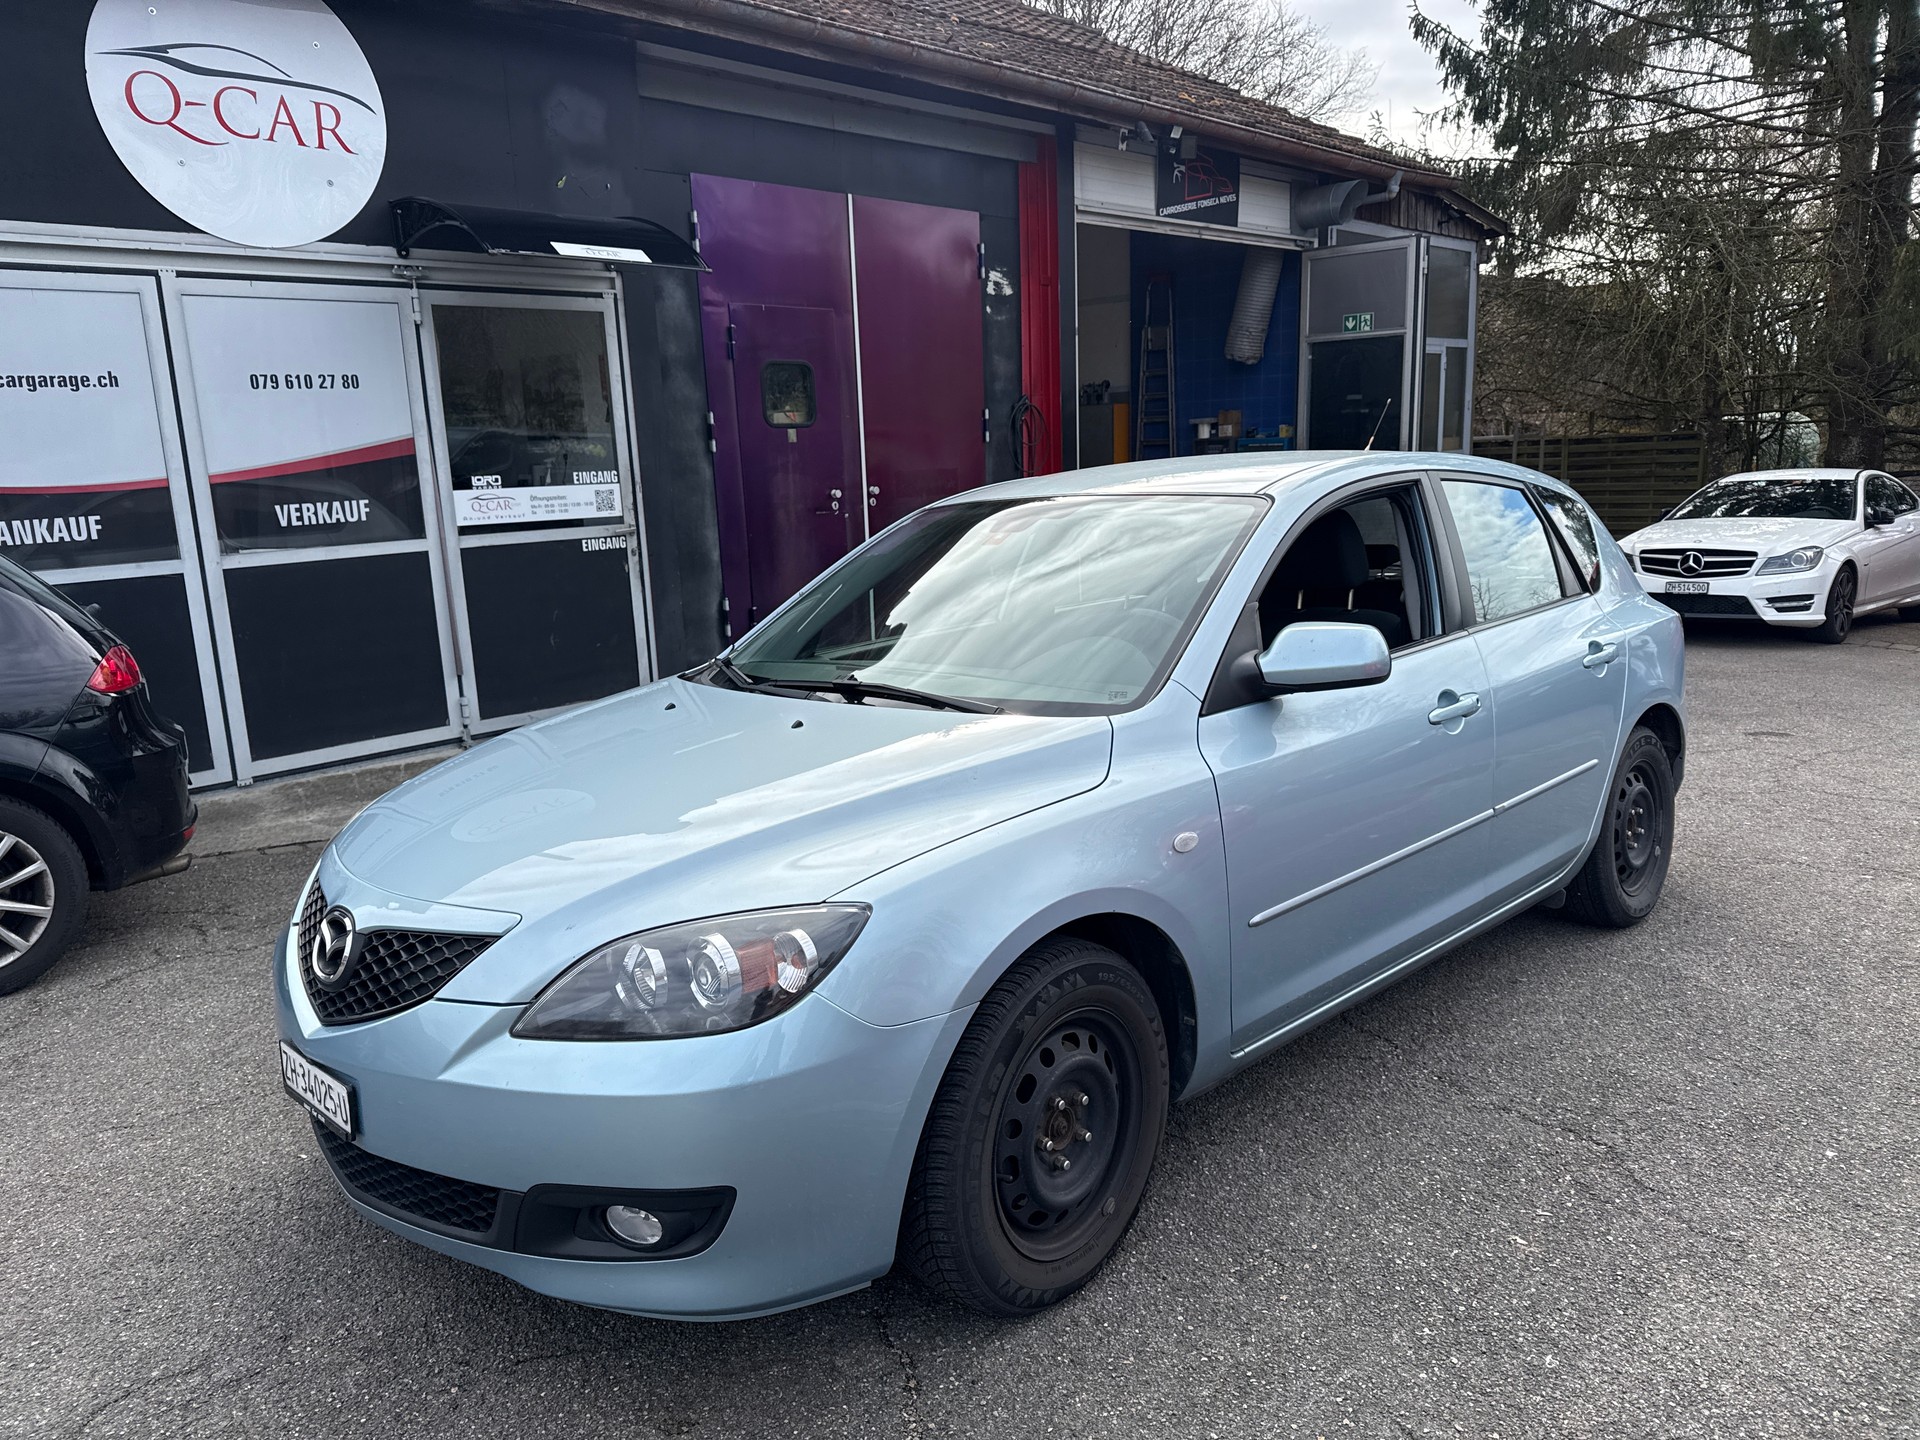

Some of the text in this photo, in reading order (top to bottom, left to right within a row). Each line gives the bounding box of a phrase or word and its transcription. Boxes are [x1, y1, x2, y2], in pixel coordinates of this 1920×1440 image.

[124, 70, 359, 155] Q-CAR
[1159, 194, 1237, 216] CARROSSERIE FONSECA NEVES
[249, 374, 360, 390] 079 610 27 80
[573, 470, 618, 485] EINGANG
[274, 499, 370, 527] VERKAUF
[471, 500, 513, 514] Q-CAR
[0, 515, 102, 546] ANKAUF
[581, 537, 627, 552] EINGANG
